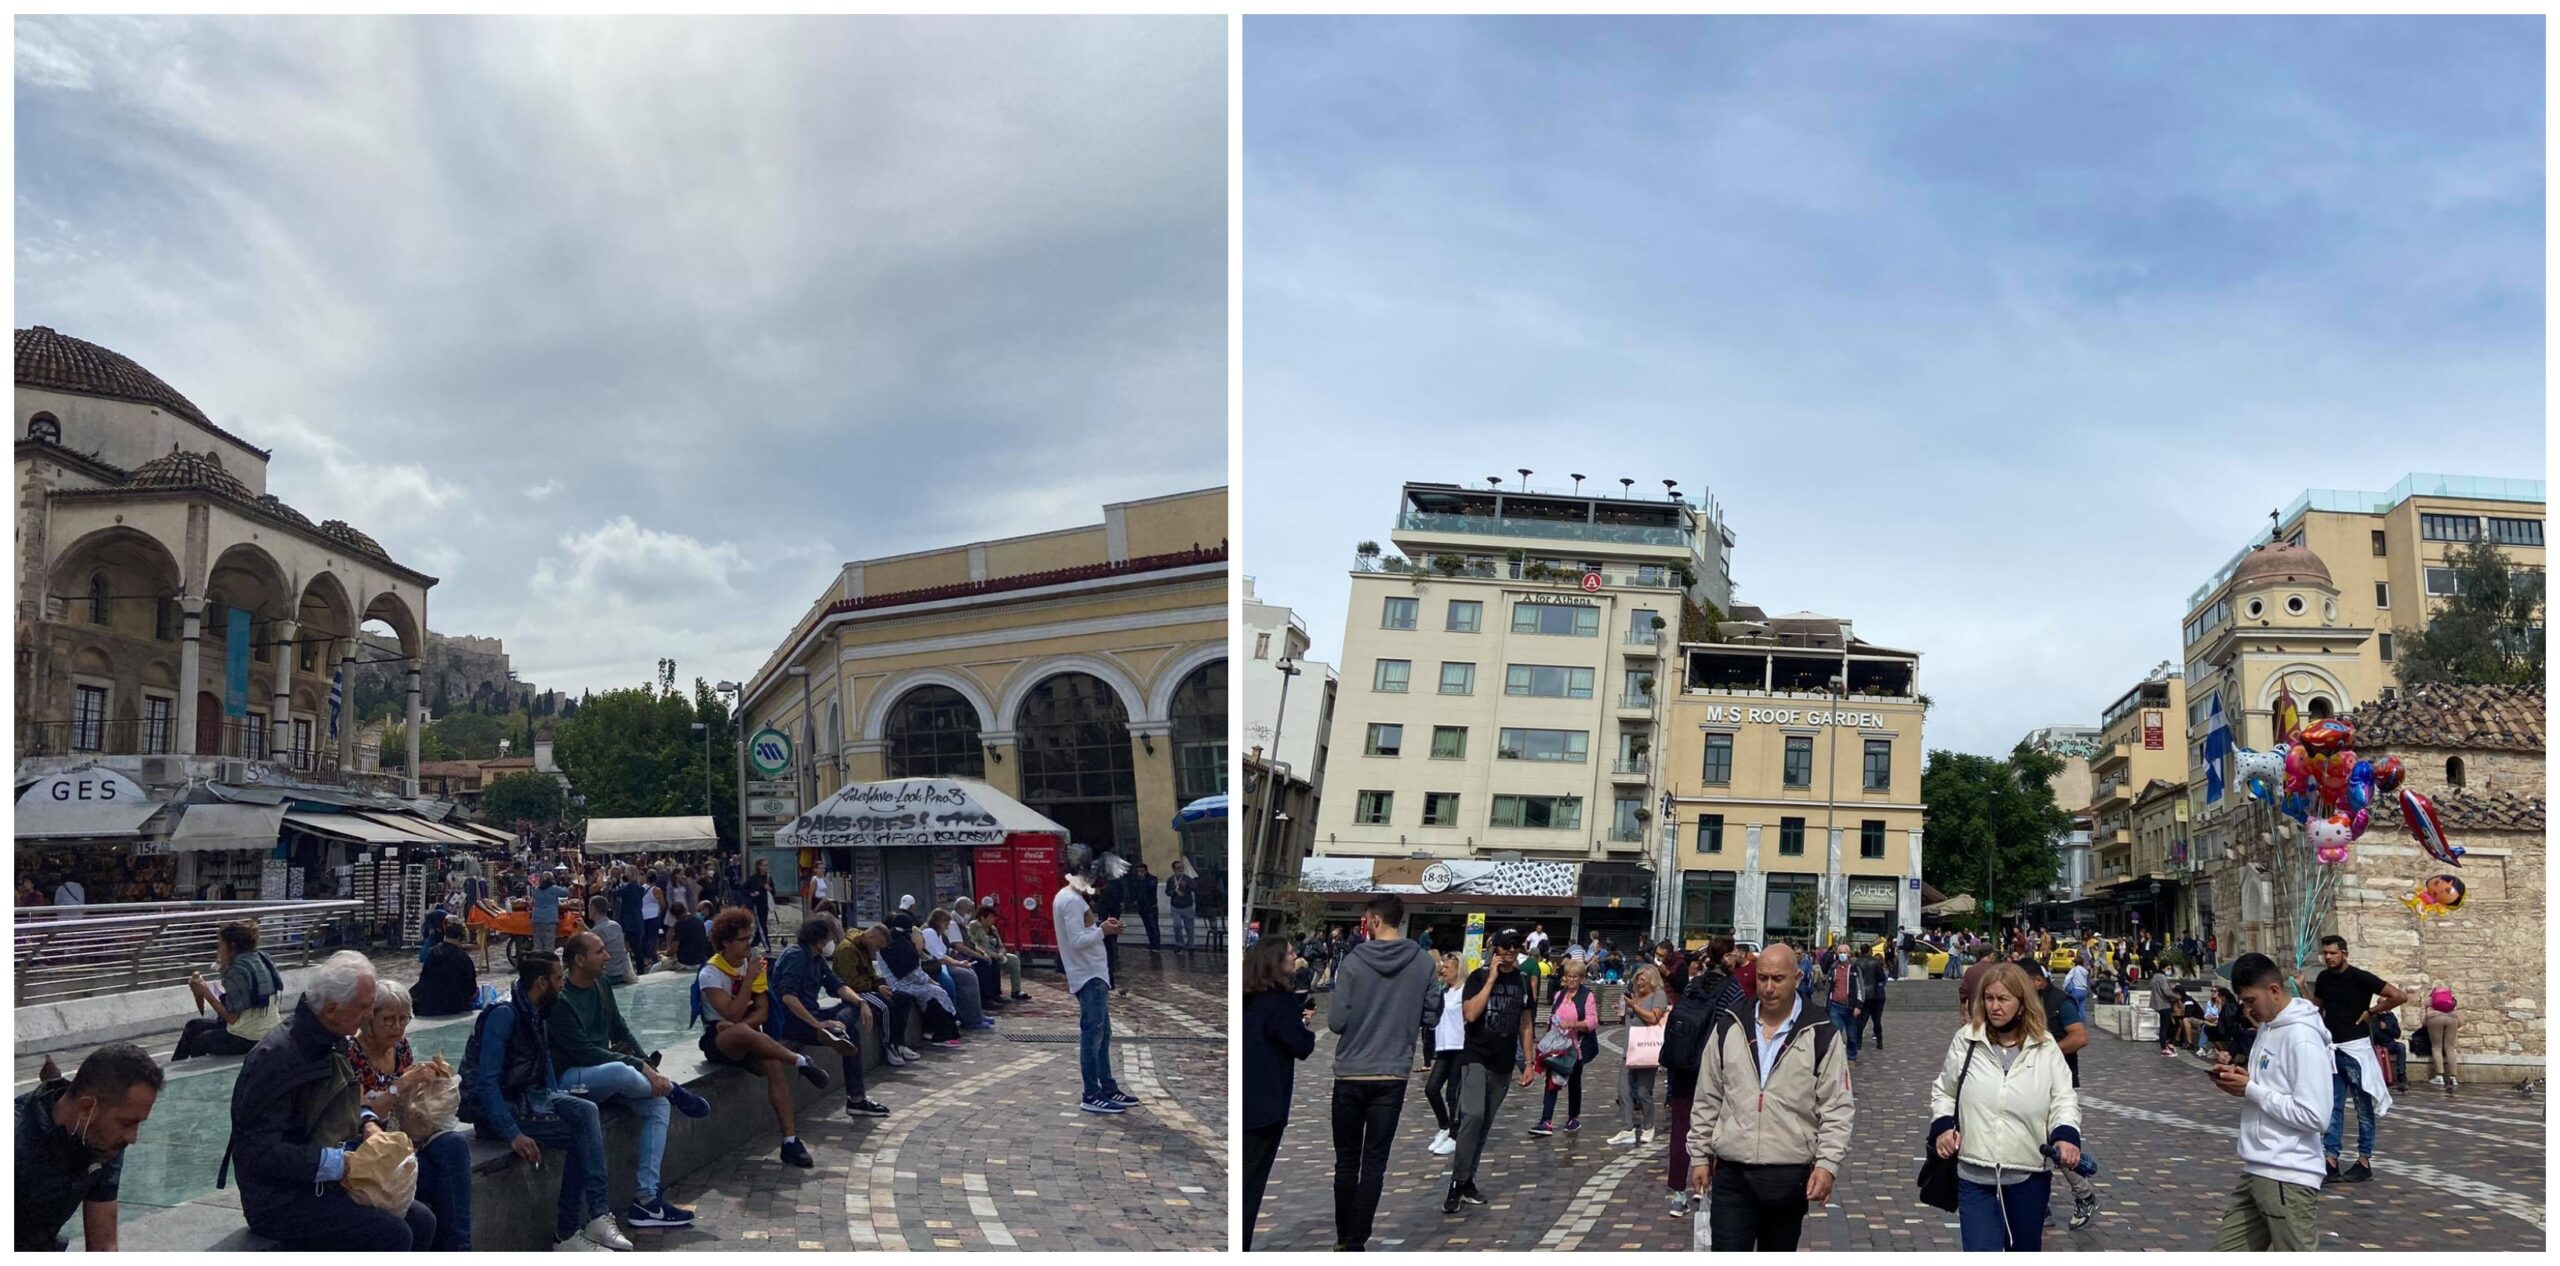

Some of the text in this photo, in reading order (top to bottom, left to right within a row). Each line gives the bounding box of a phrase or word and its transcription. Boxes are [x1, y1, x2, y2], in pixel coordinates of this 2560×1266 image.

[1523, 593, 1532, 602] A
[1537, 593, 1551, 604] for
[1748, 708, 1801, 725] ROOF
[1807, 710, 1885, 728] GARDEN
